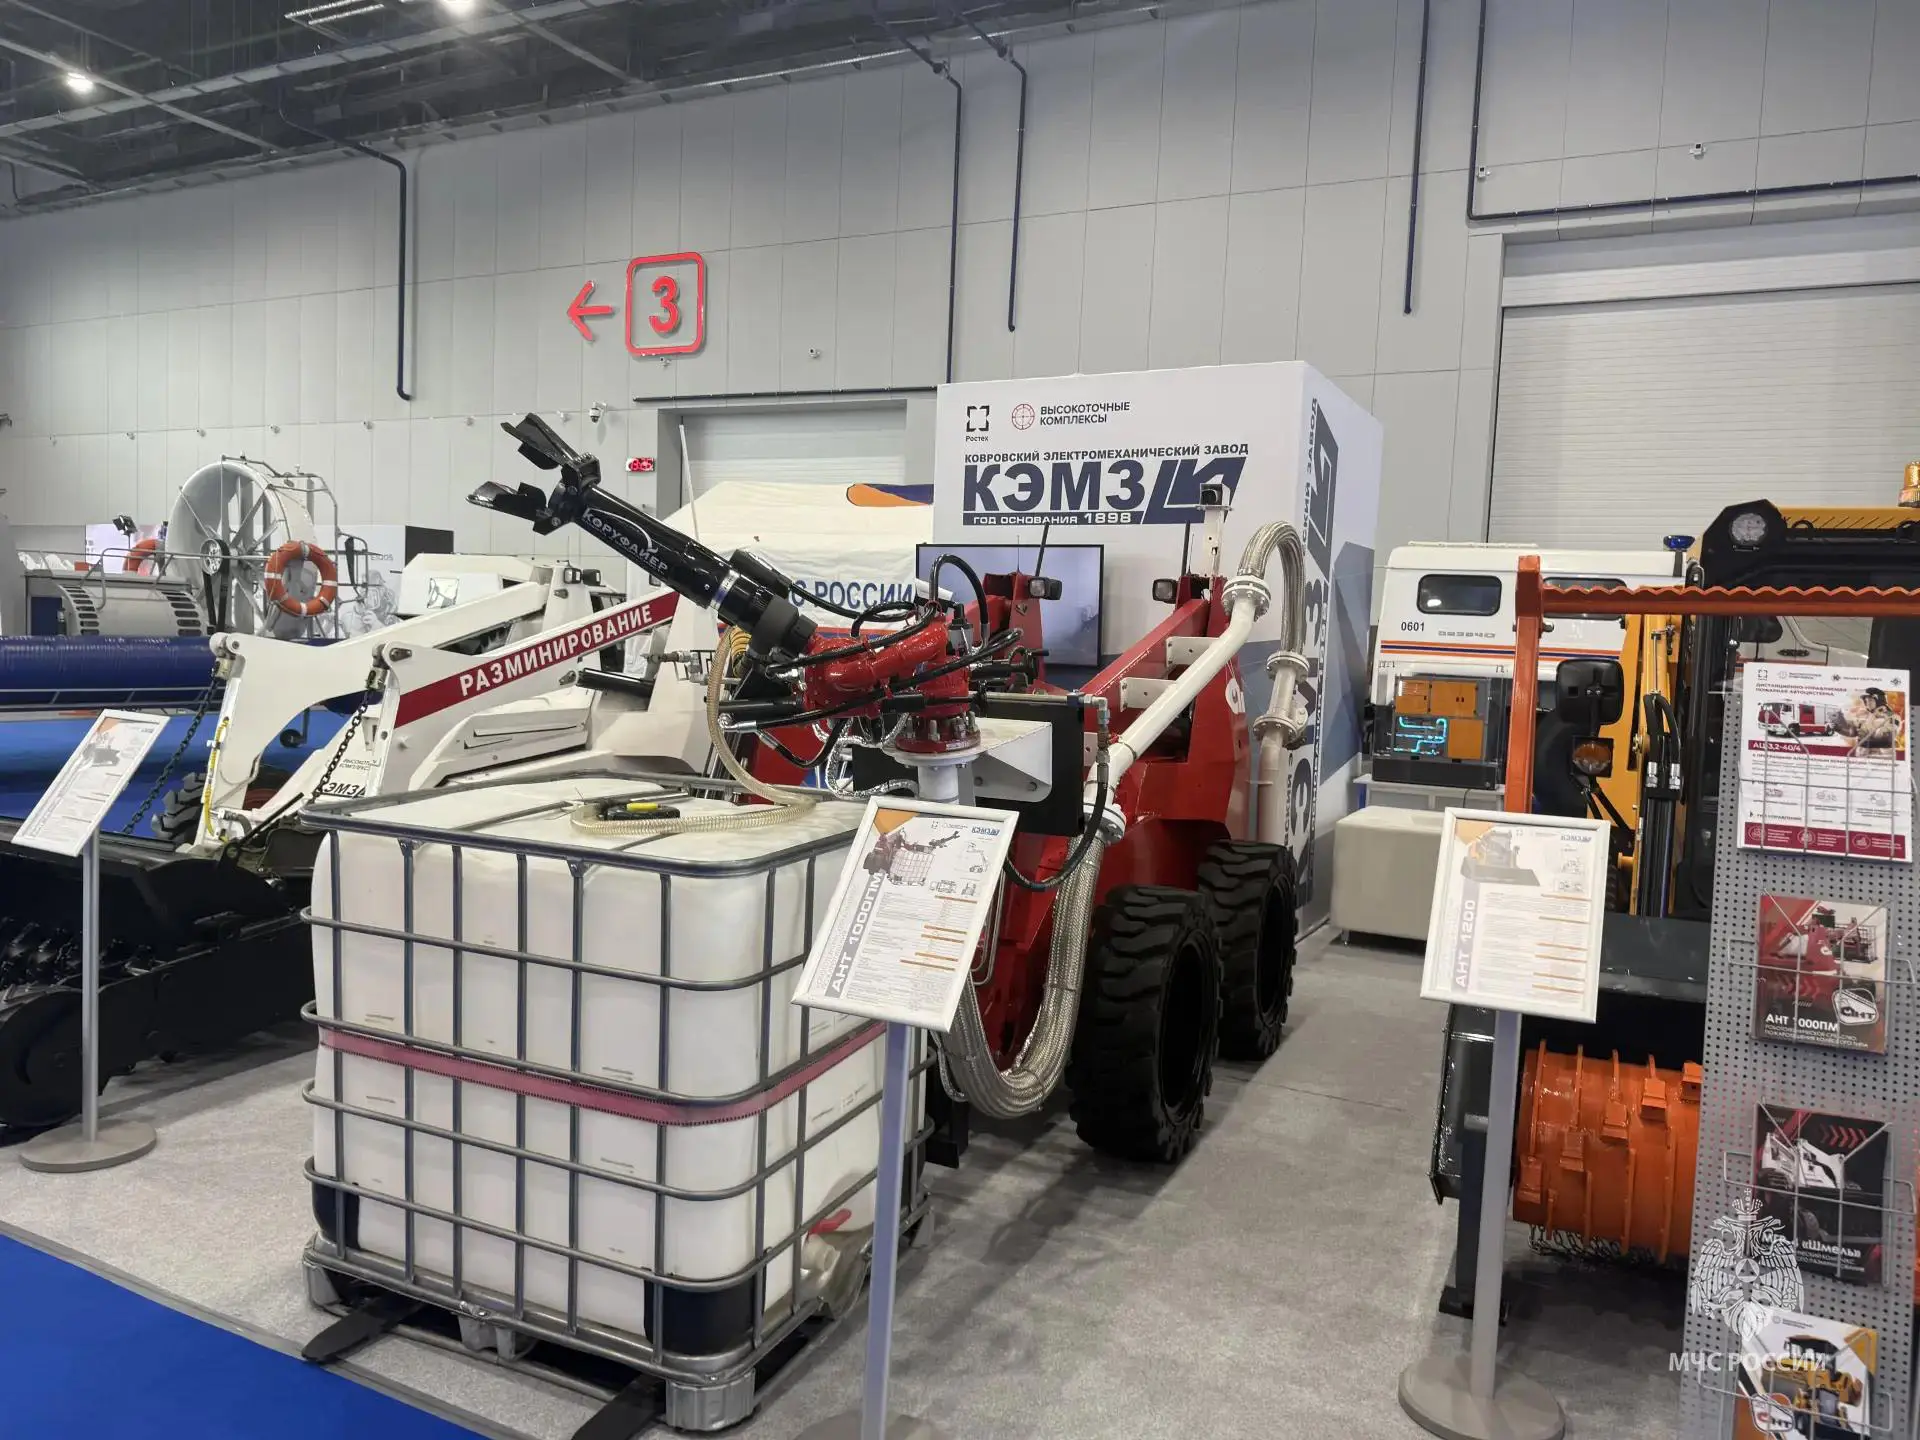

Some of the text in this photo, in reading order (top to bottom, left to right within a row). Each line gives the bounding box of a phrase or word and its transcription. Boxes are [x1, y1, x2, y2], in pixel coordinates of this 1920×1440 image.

[649, 276, 678, 333] 3
[1040, 402, 1131, 415] ВЫСОКОТОЧНЫЕ
[1040, 414, 1107, 426] КОМПЛЕКСЫ
[965, 444, 1249, 464] КОВРОВСКИЙ ЭЛЕКТРОМЕХАНИЧЕСКИЙ ЗАВОД
[963, 459, 1145, 512] КЭМЗ
[973, 511, 1132, 525] ГОД ОСНОВАНИЯ 1898
[1401, 621, 1425, 632] 0601
[459, 604, 652, 697] РАЗМИНИРОВАНИЕ
[831, 951, 848, 993] АНТ
[849, 871, 884, 945] 1000ПМ
[1455, 953, 1470, 988] АНТ
[1765, 1013, 1838, 1031] АНТ 000ПМ
